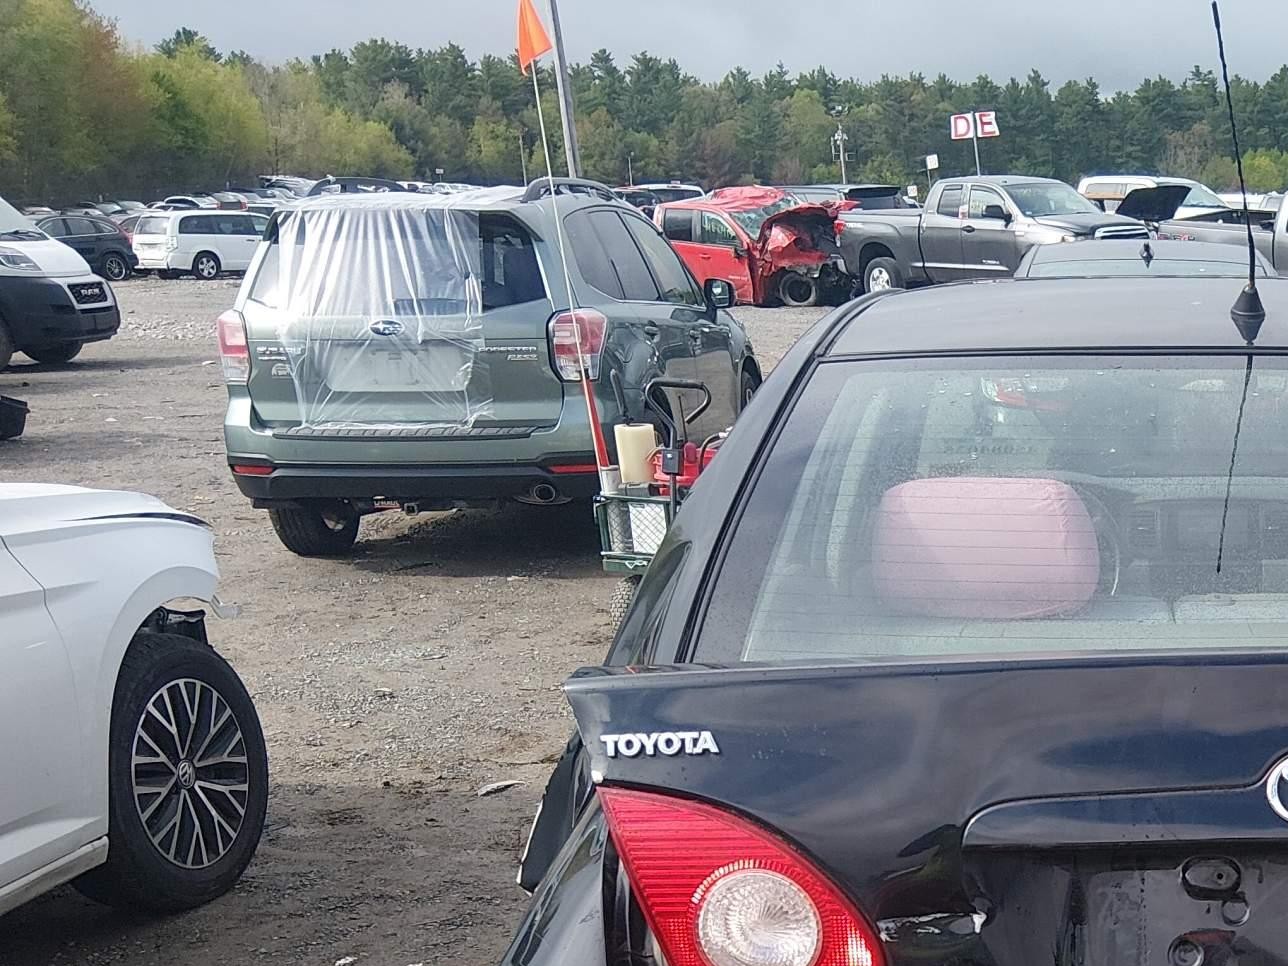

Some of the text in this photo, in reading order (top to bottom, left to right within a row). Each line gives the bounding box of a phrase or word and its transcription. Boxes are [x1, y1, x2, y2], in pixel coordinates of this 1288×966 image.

[953, 113, 996, 138] D E
[600, 731, 720, 757] TOYOTA
